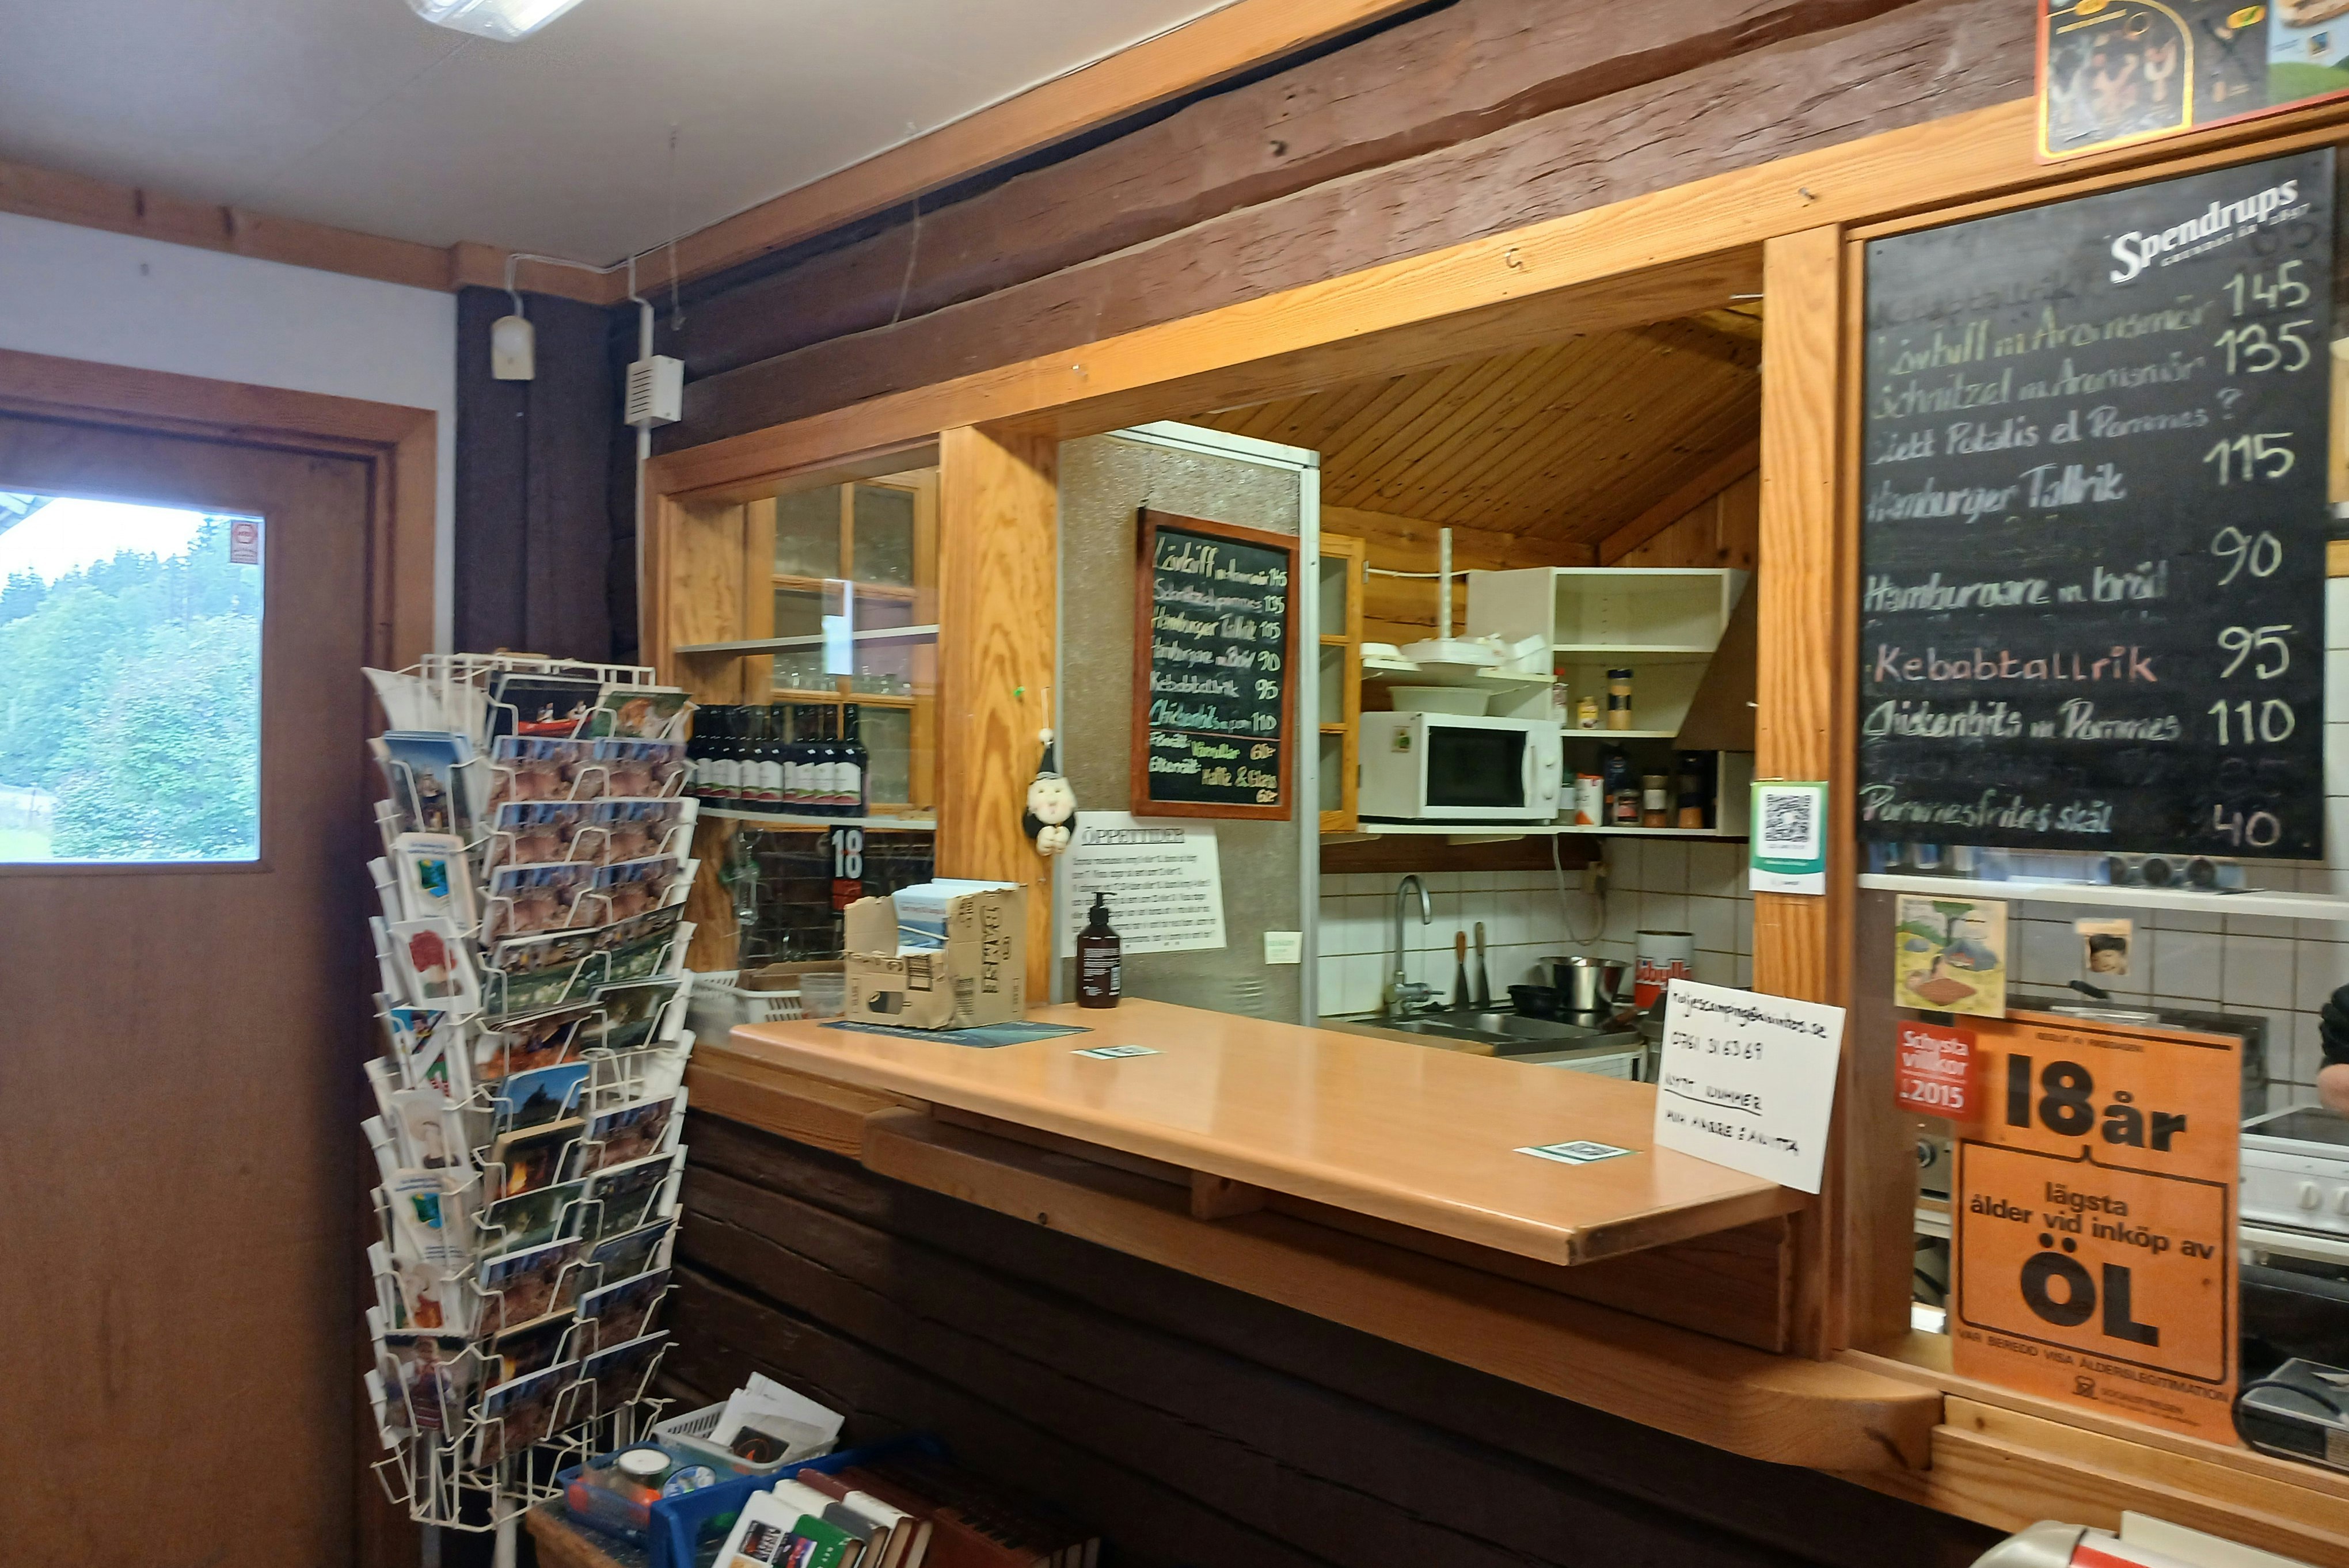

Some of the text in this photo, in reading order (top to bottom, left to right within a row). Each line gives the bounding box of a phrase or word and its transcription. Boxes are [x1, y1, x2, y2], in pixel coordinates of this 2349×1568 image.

[2109, 180, 2298, 283] Spendrups
[2222, 260, 2311, 316] 145
[2214, 319, 2313, 375] 135
[2203, 432, 2295, 486] 115
[2211, 526, 2282, 586] 90
[1257, 651, 1280, 671] 90
[1875, 625, 2293, 683] Kebabtallrik 95
[1255, 679, 1279, 700] 95
[2207, 699, 2295, 745] 110
[831, 829, 862, 878] 18
[2214, 804, 2280, 847] 40
[2006, 1053, 2187, 1152] 18 år
[1970, 1193, 2215, 1260] ålder vid inköp av
[2045, 1181, 2128, 1217] lägsta
[2020, 1232, 2159, 1348] ÖL
